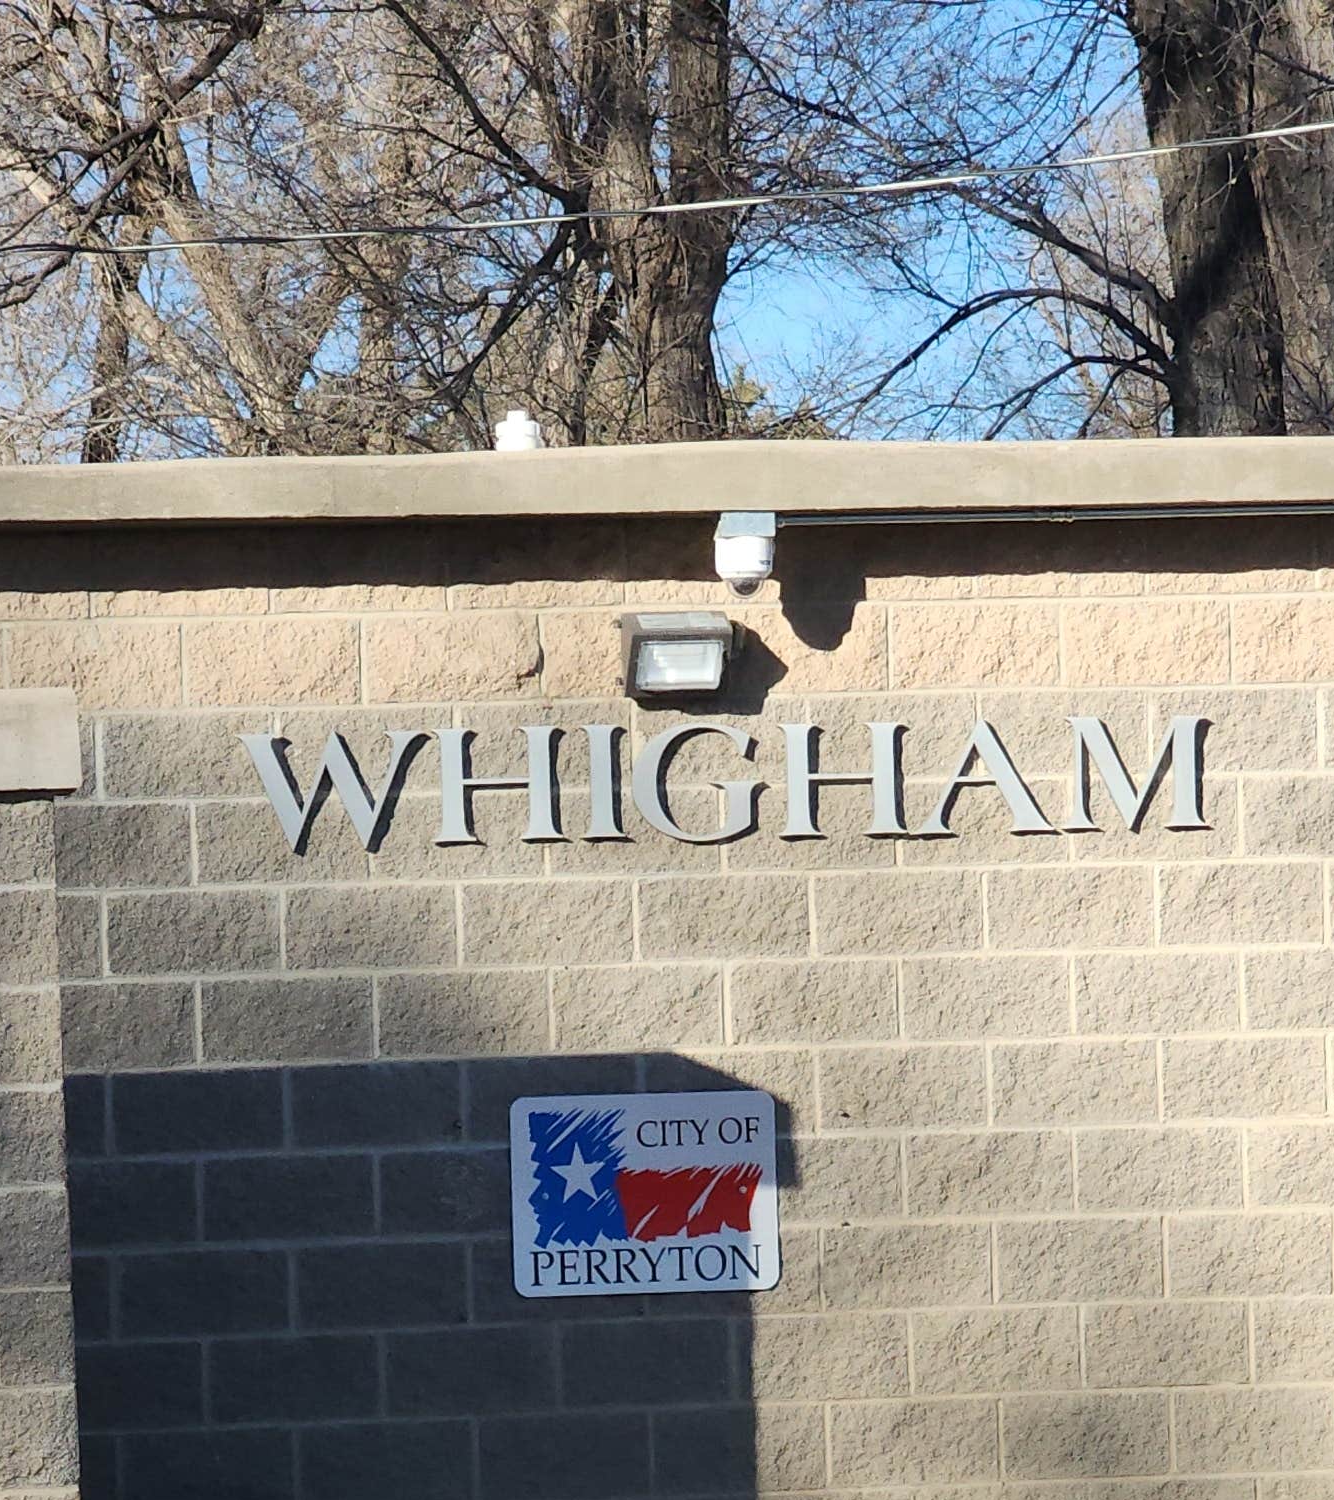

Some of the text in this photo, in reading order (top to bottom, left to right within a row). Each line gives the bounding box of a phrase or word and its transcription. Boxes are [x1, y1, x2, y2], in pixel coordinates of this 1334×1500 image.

[236, 715, 1210, 853] WHIGHAM
[636, 1117, 760, 1148] CITY OF
[530, 1244, 761, 1286] PERRYTON
